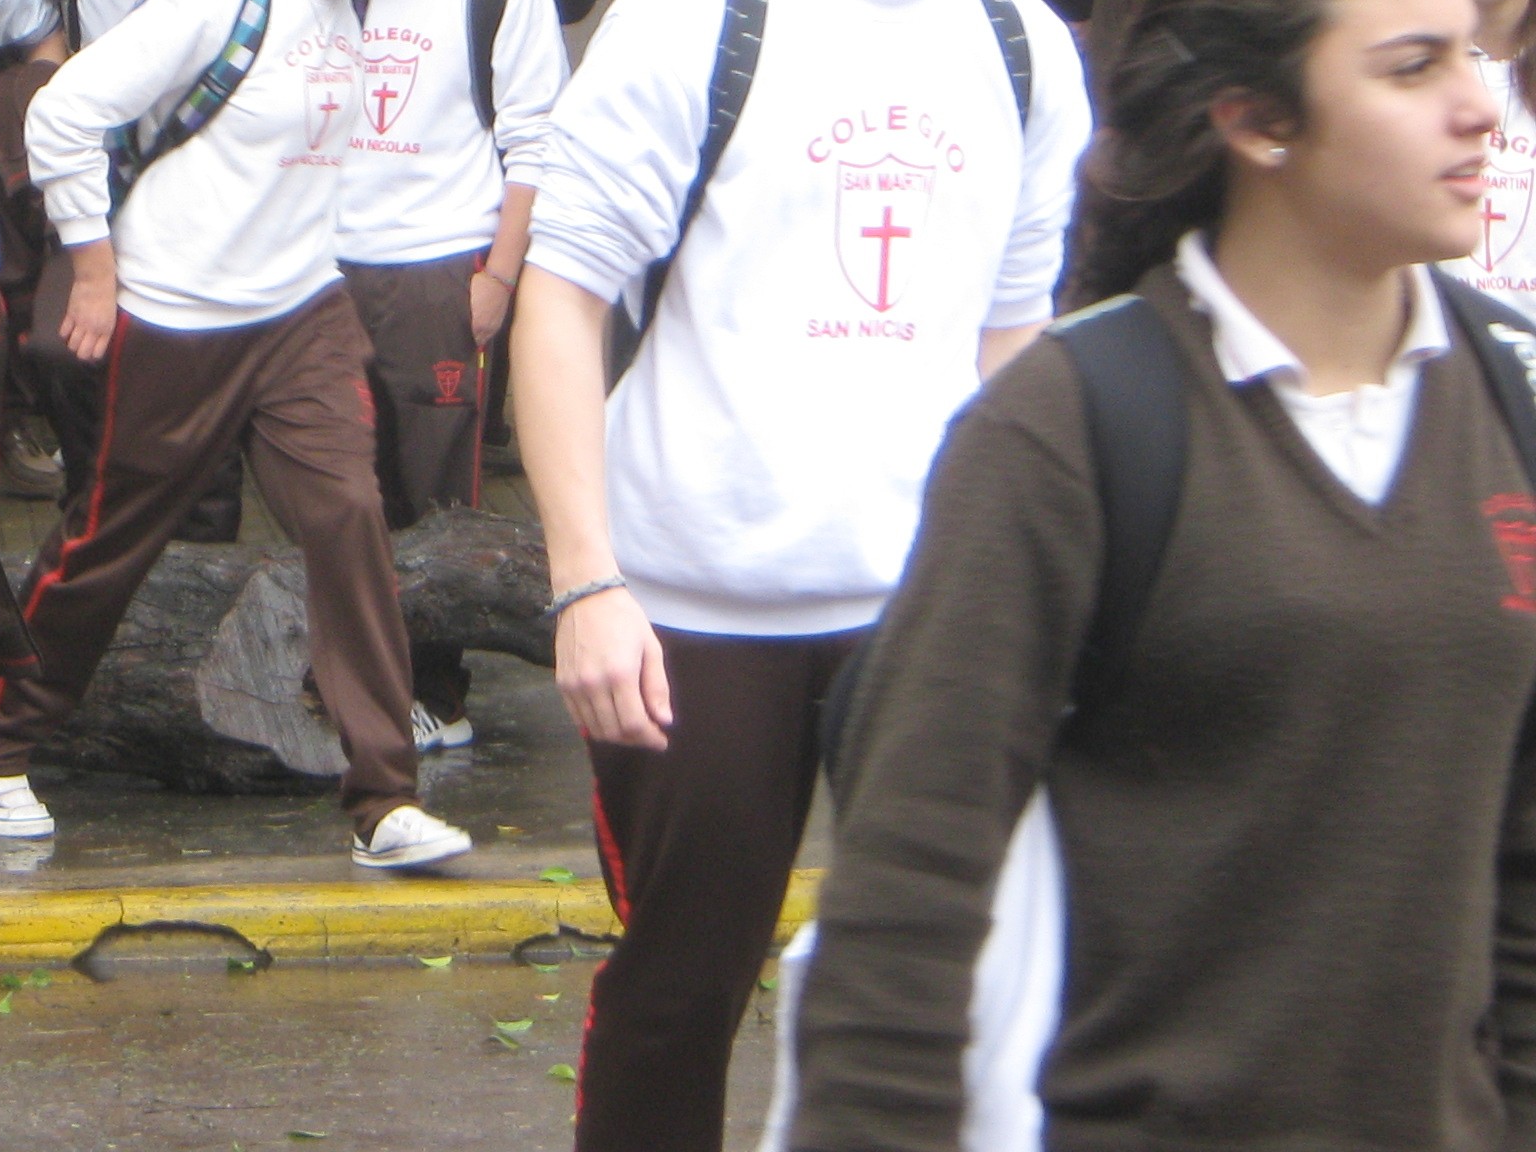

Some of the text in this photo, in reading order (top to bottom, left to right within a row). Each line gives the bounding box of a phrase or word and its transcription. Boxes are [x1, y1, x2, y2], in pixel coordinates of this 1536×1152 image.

[361, 26, 434, 53] OLEGIO
[807, 105, 965, 173] COLEGIO
[806, 318, 851, 339] SAN
